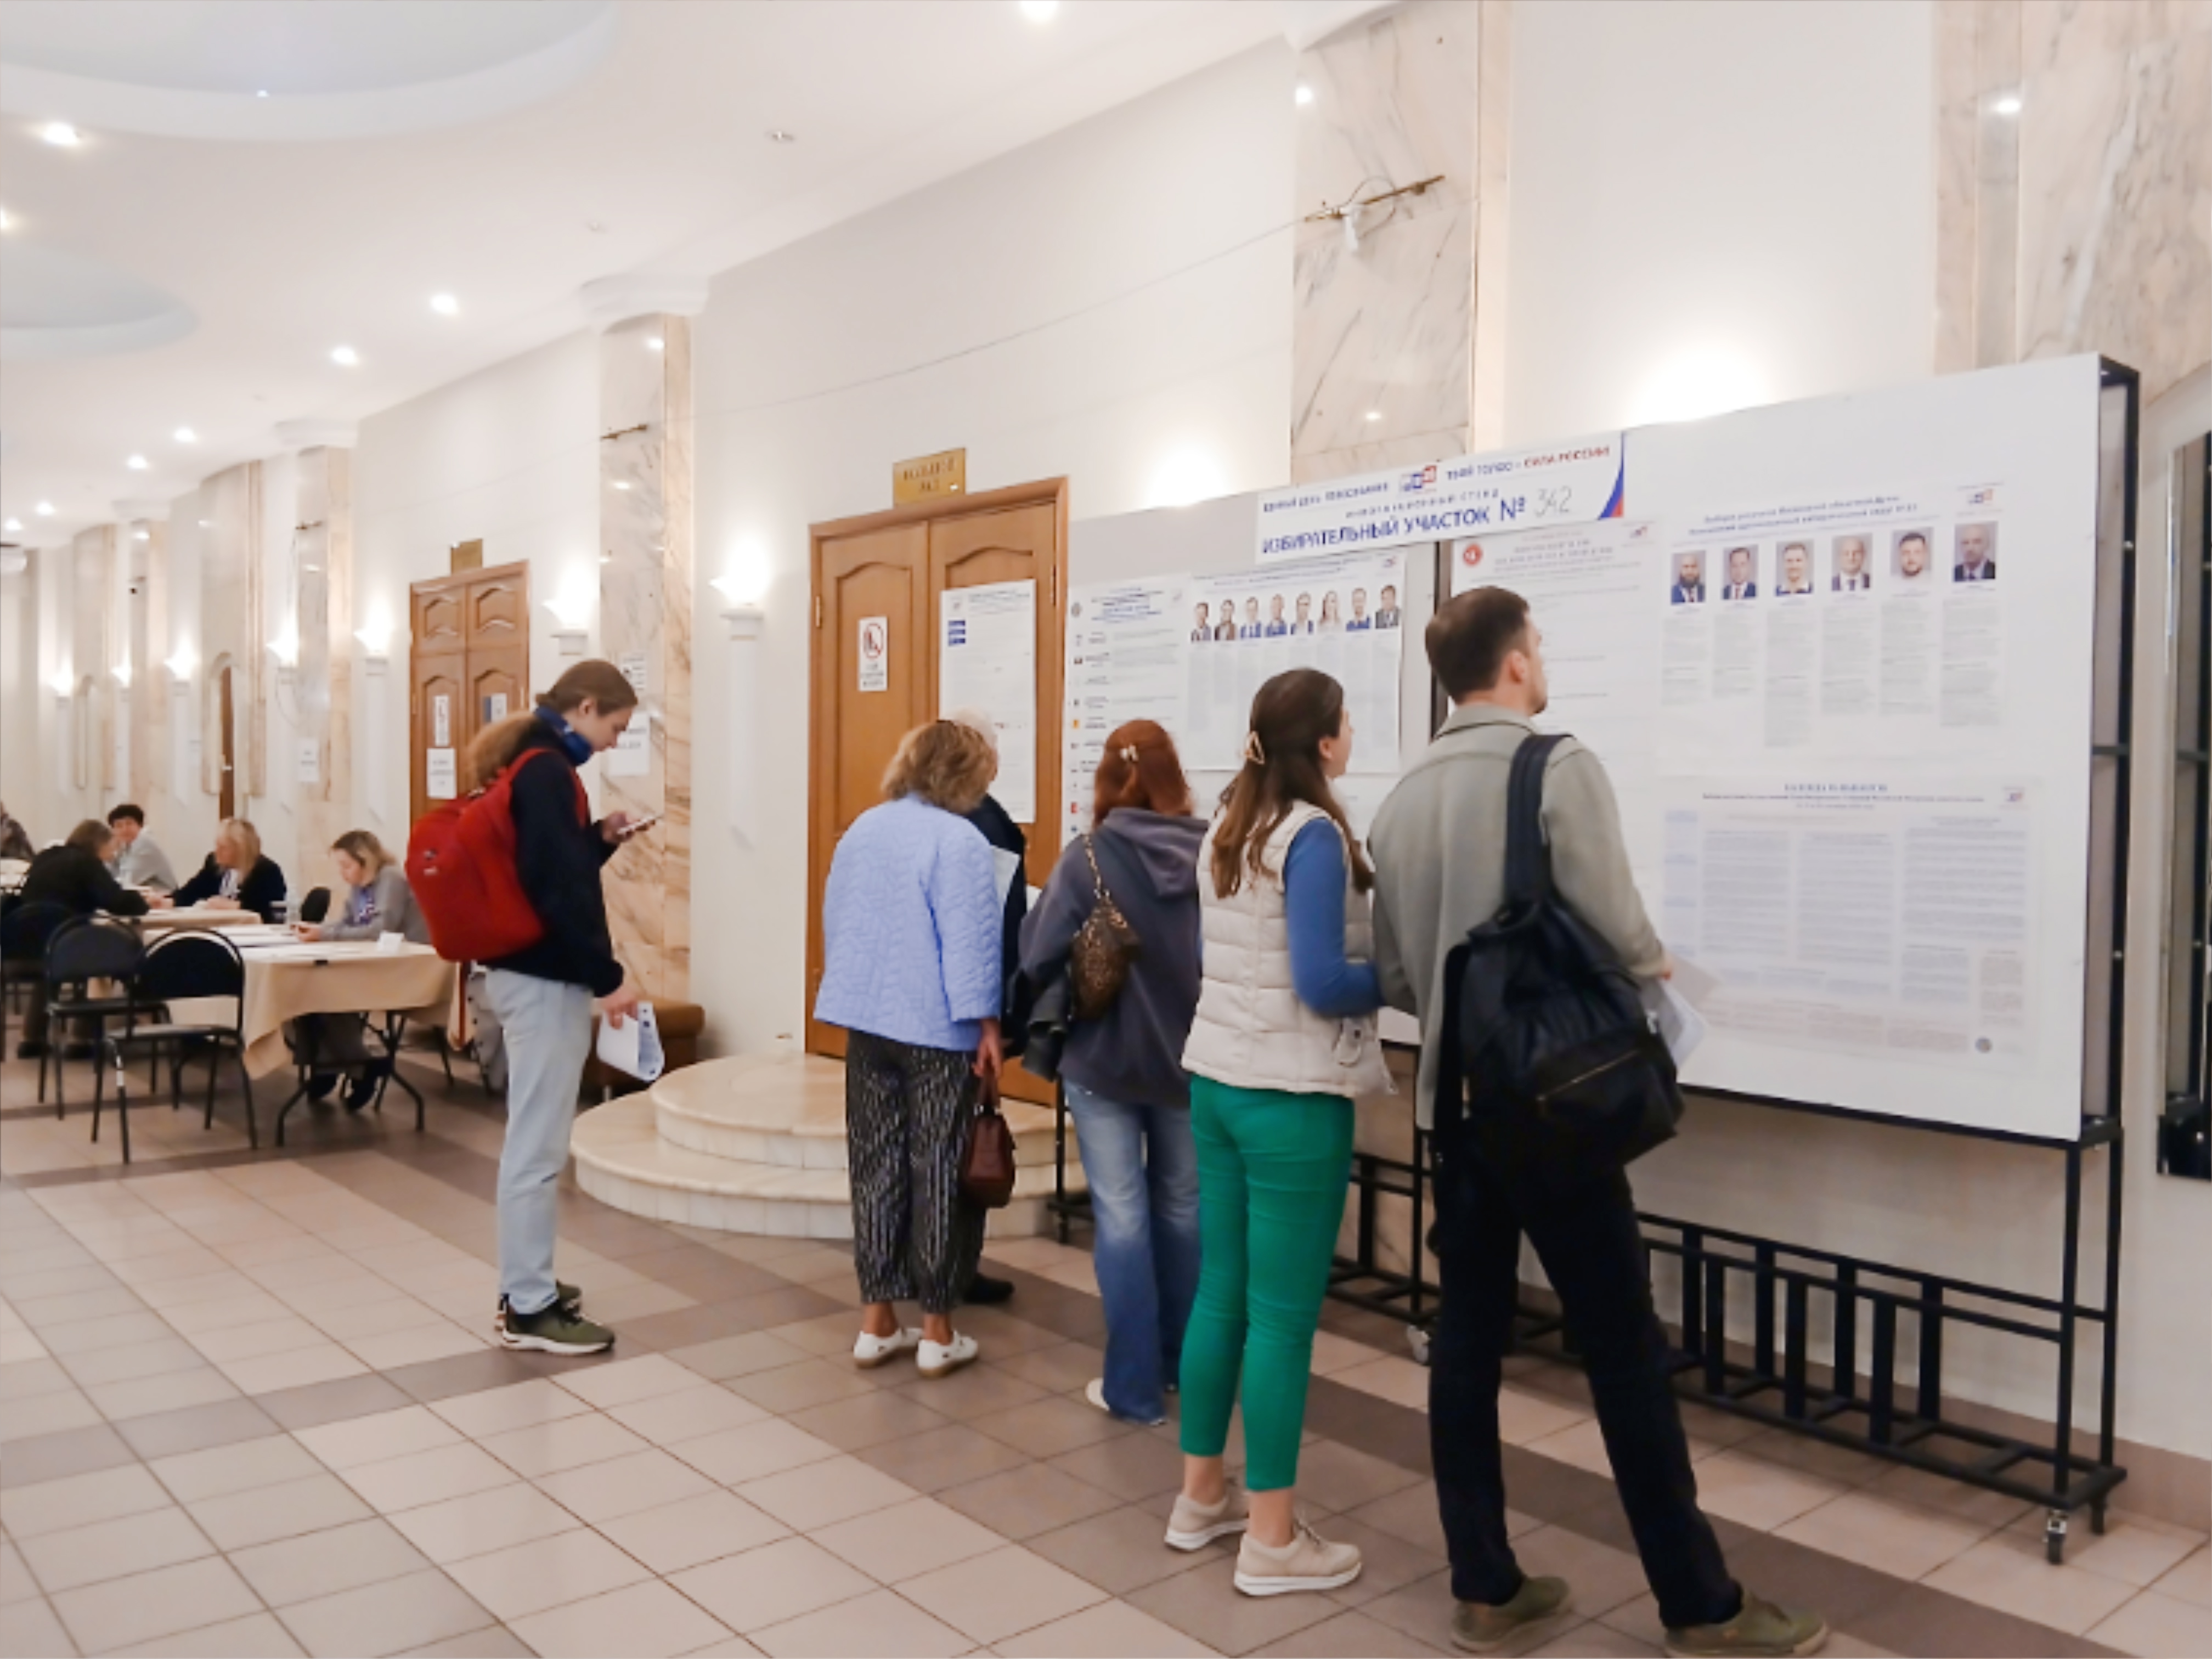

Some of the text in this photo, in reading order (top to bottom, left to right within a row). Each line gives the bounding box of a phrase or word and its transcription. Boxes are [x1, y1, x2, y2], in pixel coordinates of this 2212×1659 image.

[1534, 485, 1572, 518] 342
[1263, 496, 1526, 553] ИЗБИРАТЕЛЬНЫЙ УЧАСТОК №
